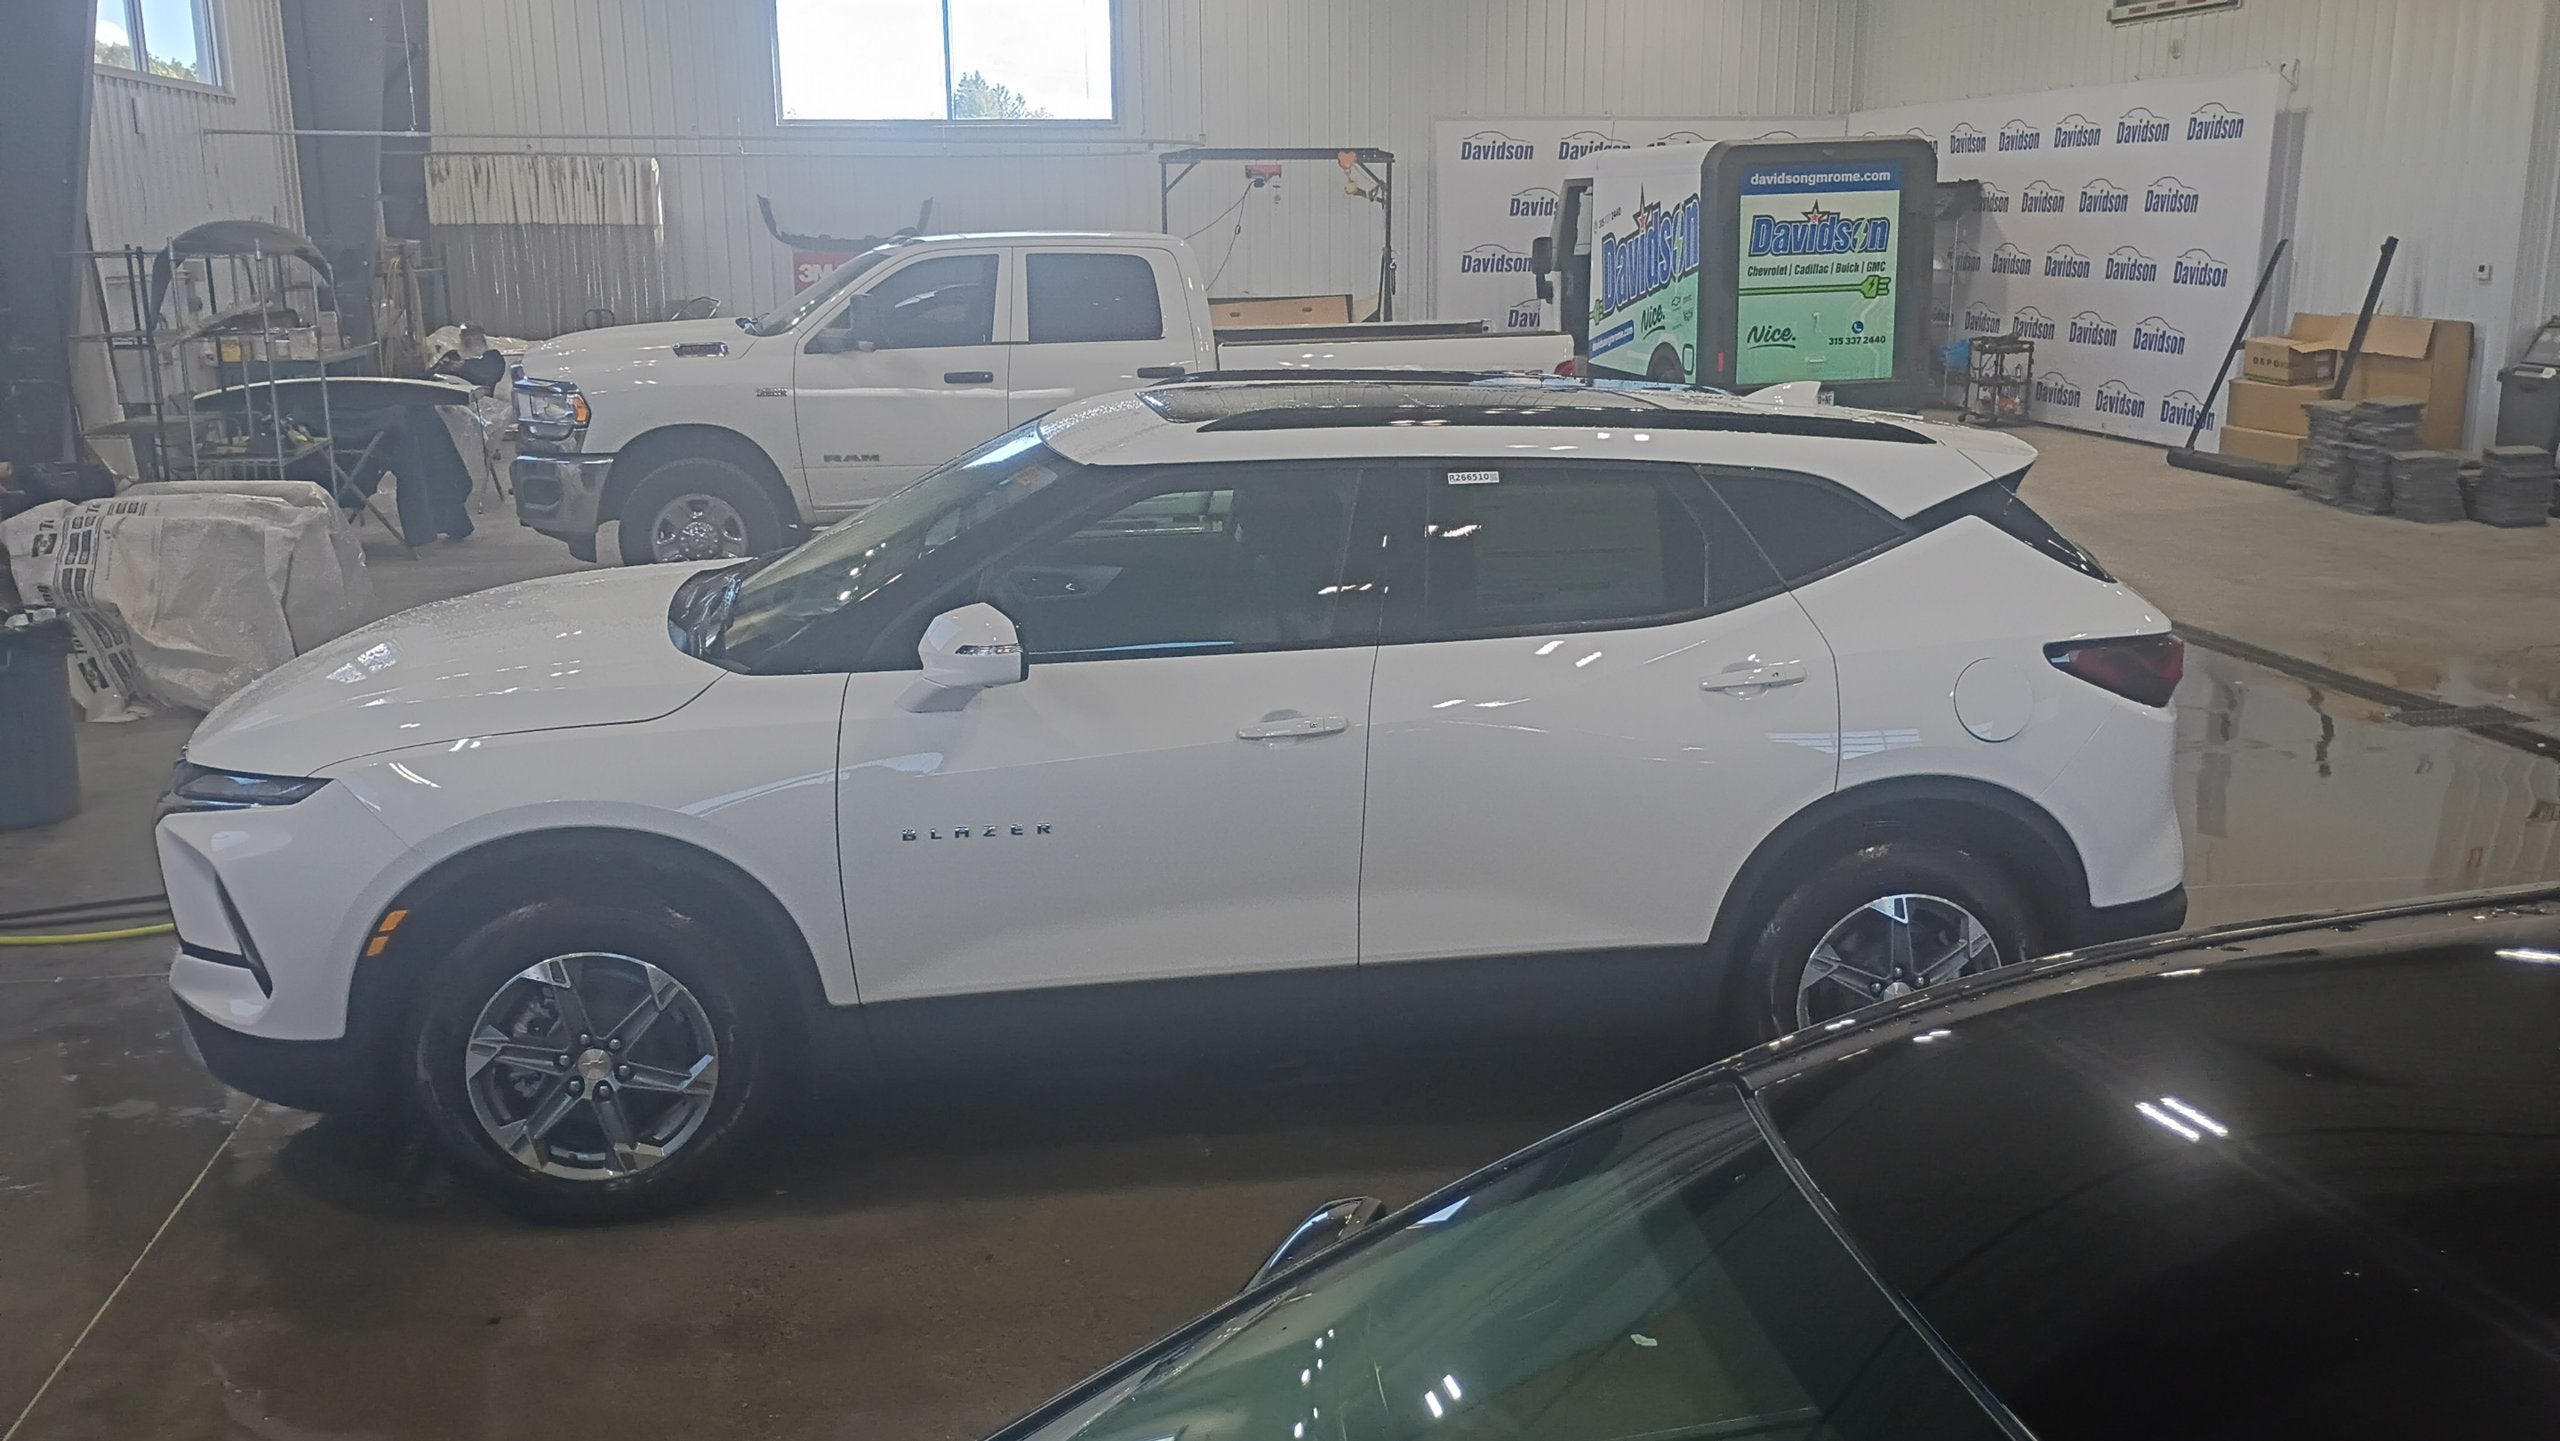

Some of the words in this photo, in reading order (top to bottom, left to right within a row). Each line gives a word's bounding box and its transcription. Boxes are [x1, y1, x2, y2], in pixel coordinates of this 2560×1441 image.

[2054, 125, 2101, 148] Davidson
[2116, 119, 2170, 144] Davidson
[2187, 114, 2244, 140] Davidson
[1461, 141, 1533, 160] Davidson
[1950, 133, 1986, 154] Davidson
[1999, 129, 2040, 151] Davidson
[1751, 172, 1891, 185] davidsongmrome.com
[2021, 191, 2064, 213] Davidson
[2079, 190, 2128, 212] Davidson
[2145, 188, 2199, 212] Davidson
[1749, 212, 1890, 257] Davidson
[1461, 254, 1533, 273] Davidson
[1602, 194, 1699, 316] Davidson
[1992, 253, 2031, 275] Davidson
[2044, 255, 2090, 278] Davidson
[1747, 265, 1788, 276] Chevrolet
[1794, 263, 1828, 275] Cadillac
[1836, 262, 1859, 273] Buick
[1866, 261, 1886, 272] GMC
[2105, 257, 2157, 282] Davidson
[2173, 261, 2228, 287] Davidson
[1641, 304, 1665, 331] Nice.
[1965, 311, 2000, 334] Davidson
[2013, 316, 2055, 340] Davidson
[1747, 325, 1796, 343] Nice.
[1828, 337, 1843, 345] 315
[1847, 337, 1861, 345] 337
[1863, 335, 1886, 343] 2440
[2069, 321, 2117, 347] Davidson
[2133, 327, 2185, 355] Davidson
[2036, 381, 2080, 408] Davidson
[2095, 388, 2145, 418] Davidson
[824, 454, 880, 462] RAM
[1449, 473, 1489, 482] R266510
[902, 821, 1051, 841] BLAZER
